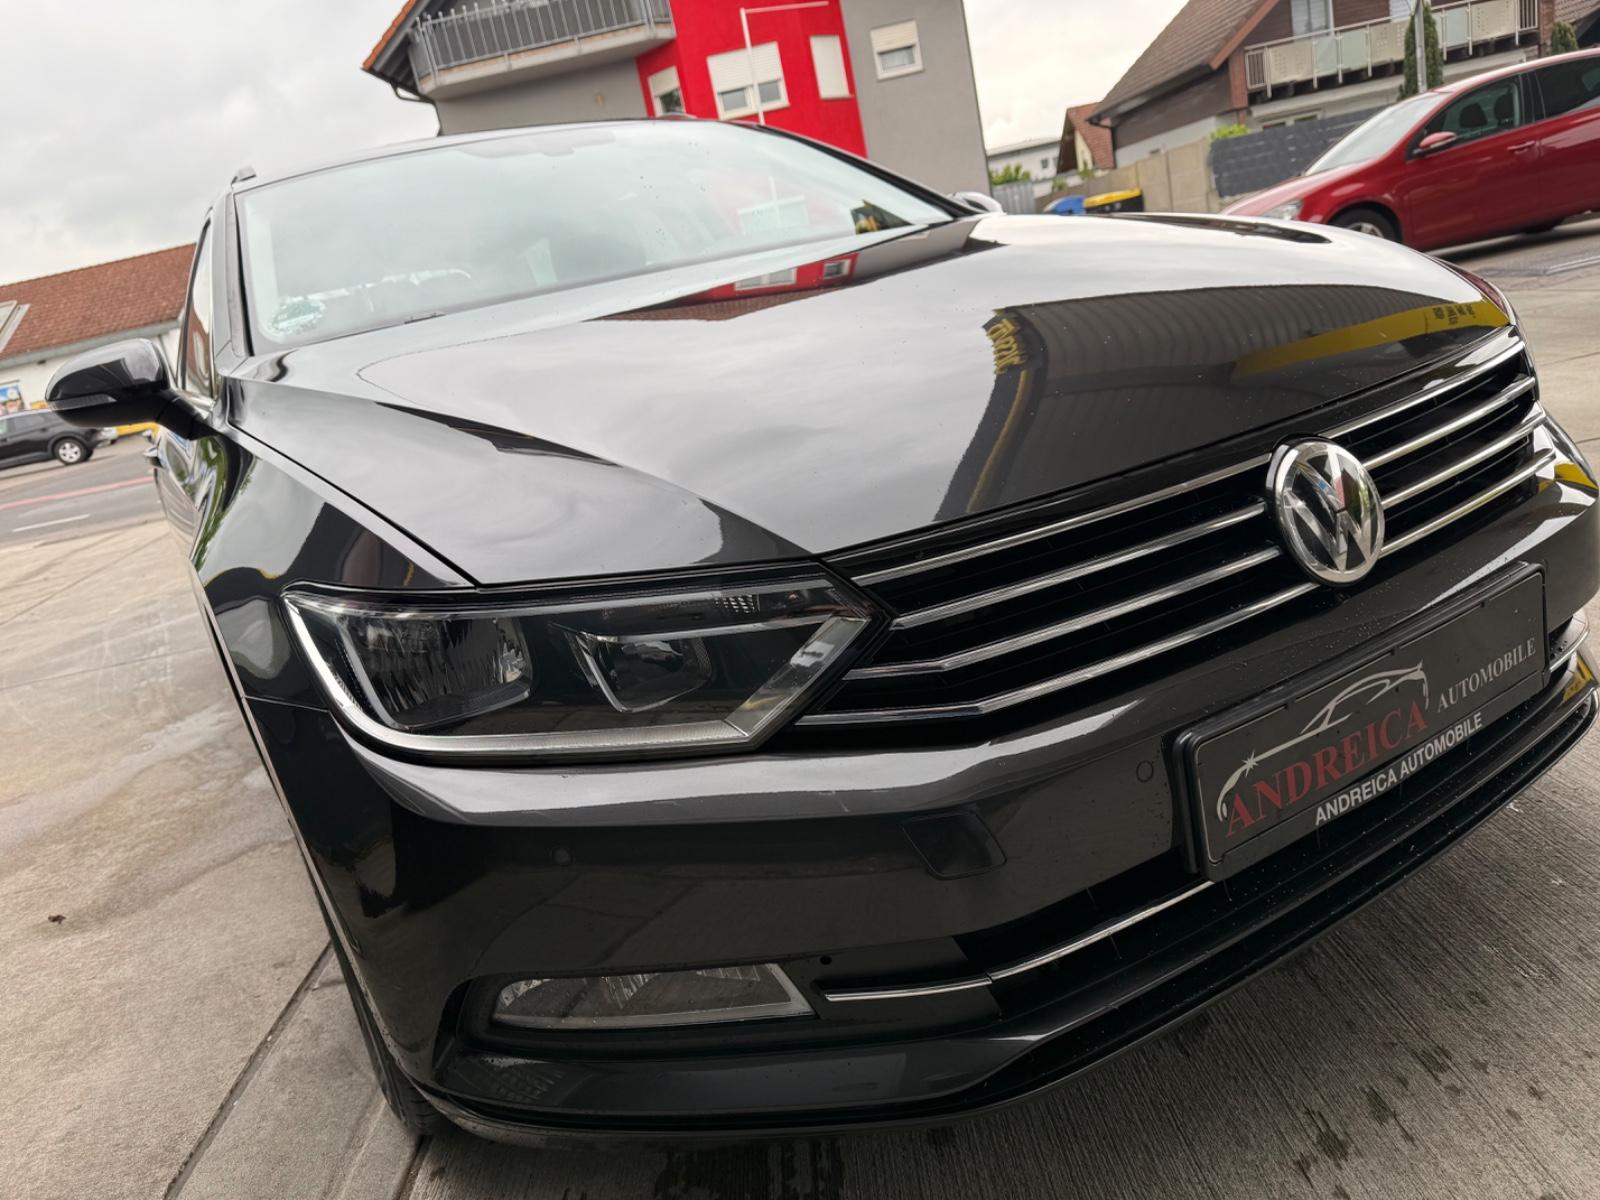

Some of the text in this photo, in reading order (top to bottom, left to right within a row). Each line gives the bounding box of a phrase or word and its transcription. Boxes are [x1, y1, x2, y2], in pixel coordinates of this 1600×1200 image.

[1225, 637, 1537, 837] ANDREICA AUTOMOBILE
[1315, 712, 1483, 826] ANDREICA AUTOMOBILE
